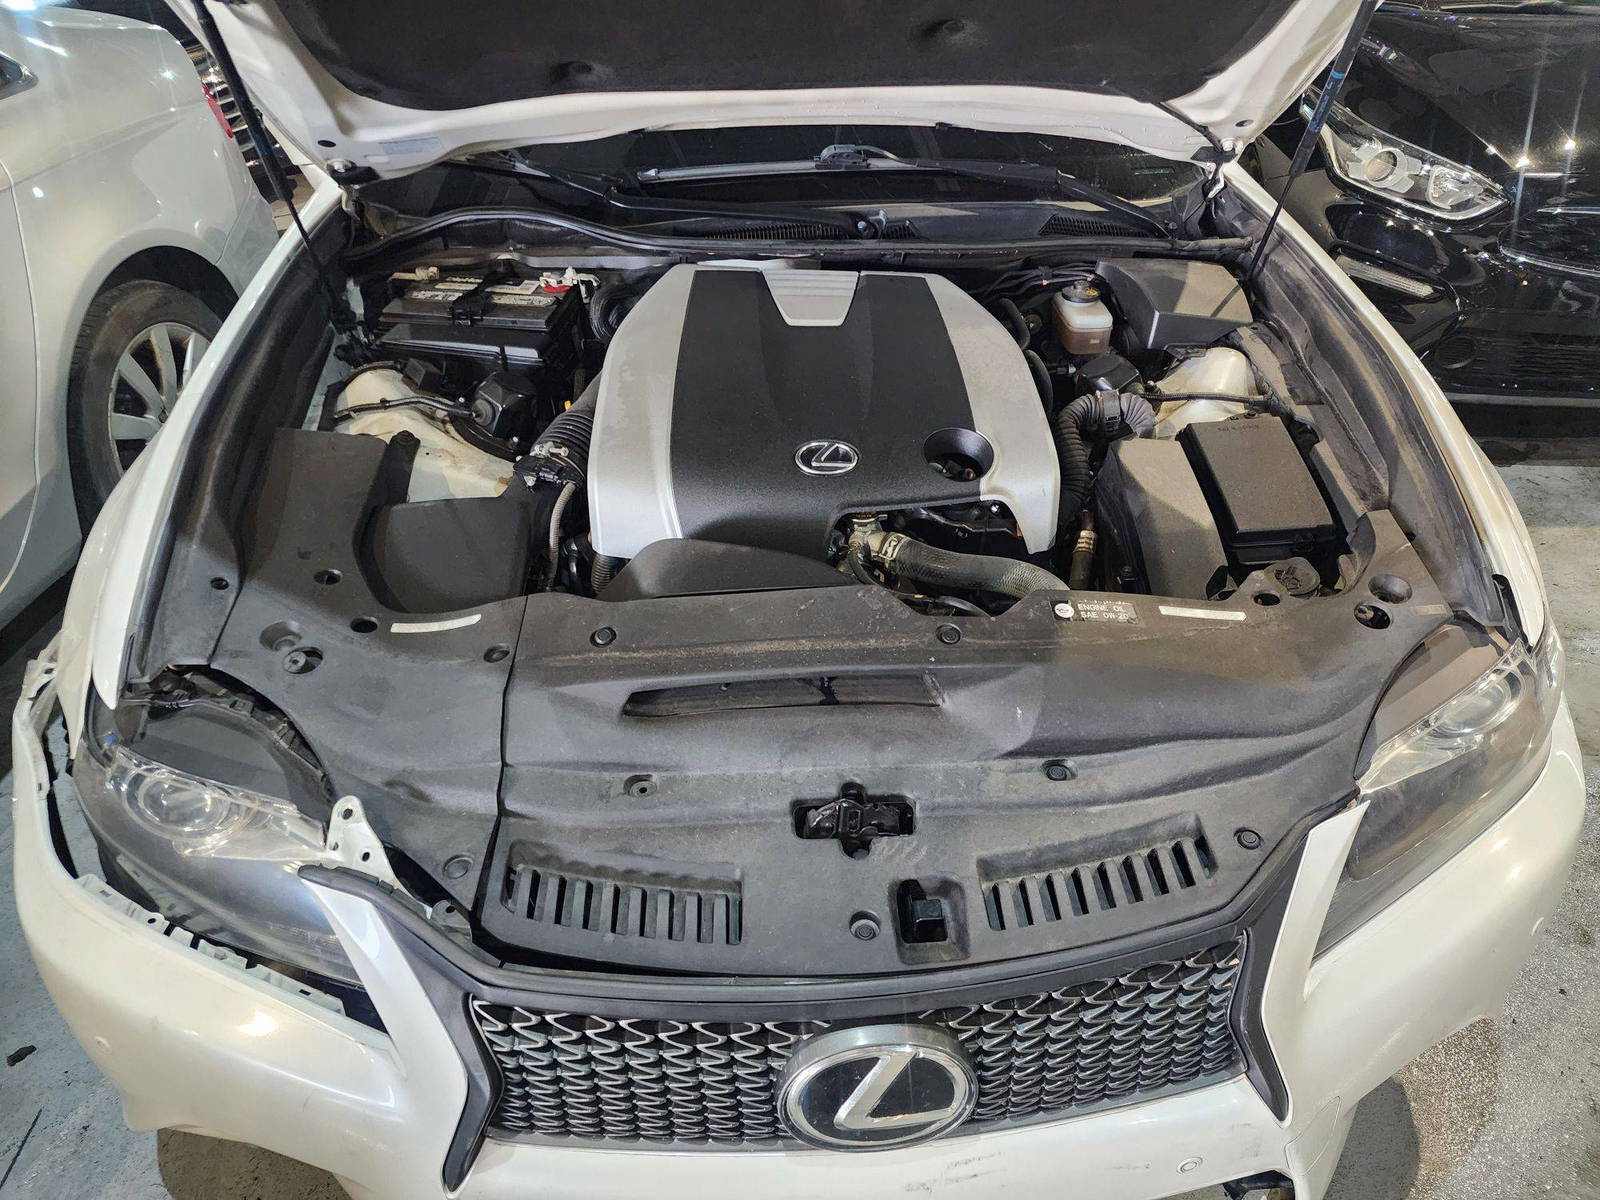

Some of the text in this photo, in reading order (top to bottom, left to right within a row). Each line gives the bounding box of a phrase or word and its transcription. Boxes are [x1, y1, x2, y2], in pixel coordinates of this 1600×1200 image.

[1077, 603, 1127, 613] ENGINE OIL
[1080, 611, 1099, 619] SAE
